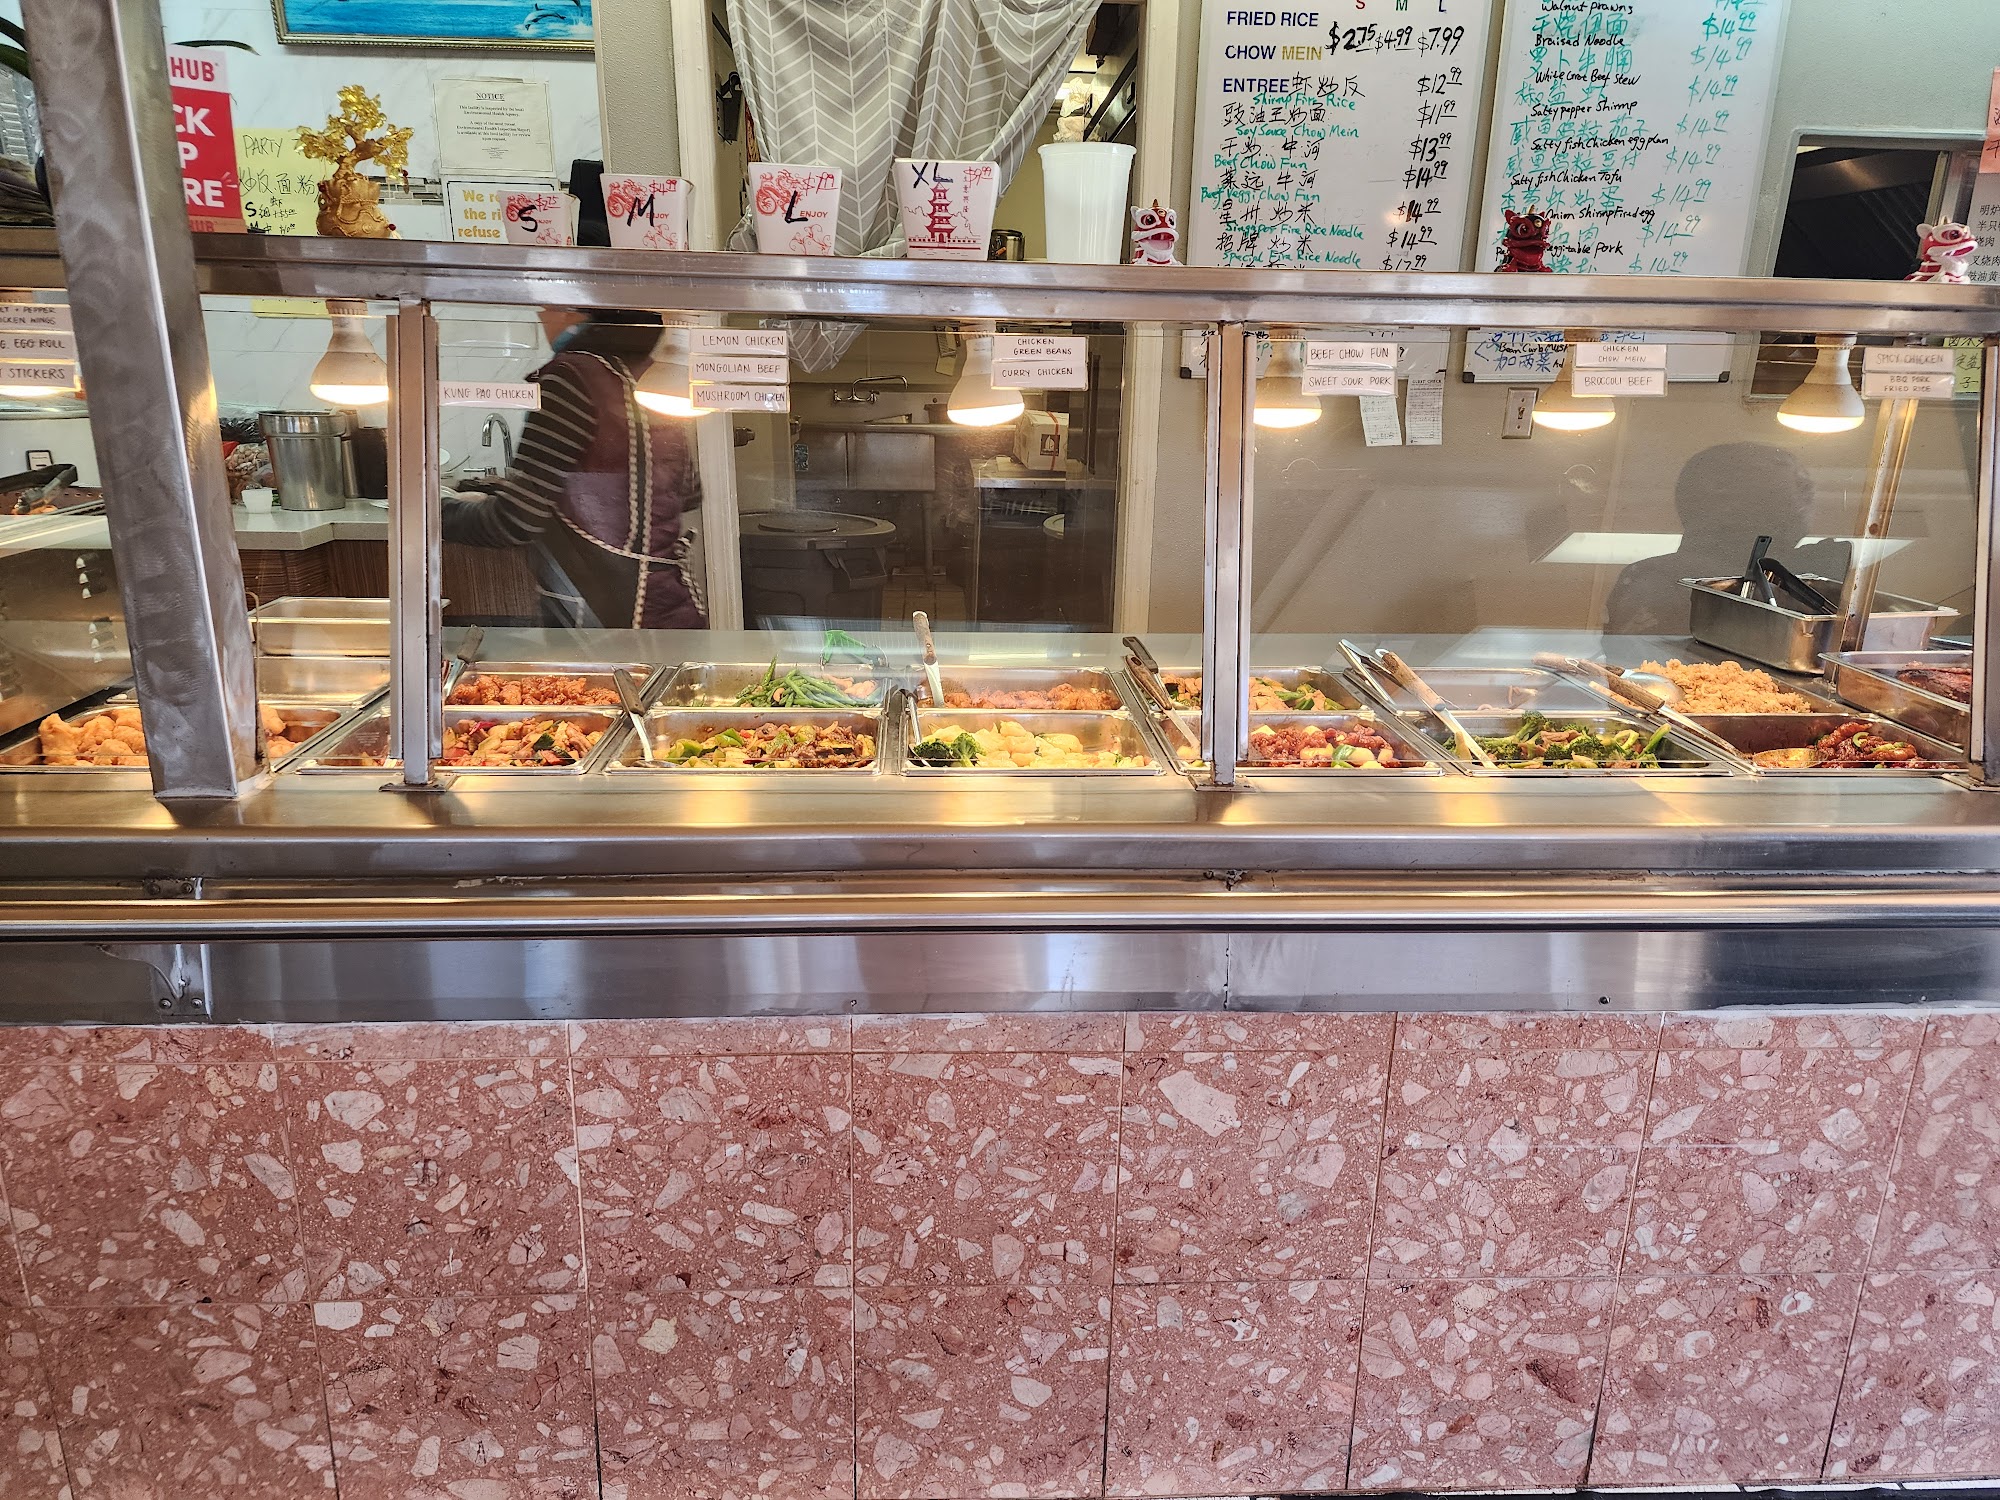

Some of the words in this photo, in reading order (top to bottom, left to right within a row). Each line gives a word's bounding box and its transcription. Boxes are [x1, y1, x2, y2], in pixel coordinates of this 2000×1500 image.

[1355, 0, 1365, 10] S
[1396, 0, 1408, 11] M
[1438, 0, 1447, 13] L
[1542, 0, 1588, 11] Walnut
[1227, 11, 1276, 26] FRIED
[1280, 12, 1319, 27] RICE
[1535, 34, 1580, 47] Braised
[1584, 33, 1624, 47] Noodle
[1225, 45, 1276, 60] CHOW
[1282, 46, 1322, 61] MEIN
[1223, 78, 1290, 93] ENTREE
[1613, 74, 1641, 86] Stew
[476, 93, 504, 101] NOTICE
[1326, 93, 1355, 110] Rice
[1293, 124, 1326, 138] Chow
[1329, 125, 1359, 138] Mein
[243, 134, 283, 158] PARTY
[1586, 135, 1625, 150] Chicken
[1240, 157, 1276, 170] Chow
[1280, 158, 1308, 170] Fun
[1557, 171, 1597, 183] Chicken
[1598, 169, 1622, 185] Tofu
[463, 190, 484, 202] We
[1259, 186, 1290, 202] Chow
[1295, 188, 1321, 202] Fun
[627, 194, 655, 227] M
[785, 190, 808, 223] L
[464, 208, 486, 220] the
[517, 204, 539, 232] S
[1305, 223, 1327, 236] Rice
[1330, 224, 1364, 239] Noodle
[1977, 220, 2000, 231] 半只
[458, 226, 500, 238] refuse
[1297, 250, 1321, 262] Rice
[1325, 251, 1362, 269] Noodle
[39, 339, 65, 349] ROLL
[702, 335, 739, 346] LEMON
[745, 335, 784, 346] CHICKEN
[1311, 348, 1334, 360] BEEF
[1339, 349, 1364, 359] CHOW
[1370, 347, 1389, 359] FUN
[1499, 342, 1521, 353] Bean
[1522, 343, 1543, 353] Curb
[1876, 354, 1900, 364] SPICY
[1904, 354, 1943, 364] CHICKEN
[8, 368, 65, 379] STICKERS
[696, 363, 750, 373] MONGOLIAN
[757, 364, 780, 373] BEEF
[1002, 369, 1030, 377] CURRY
[1037, 368, 1073, 376] CHICKEN
[1308, 376, 1338, 387] SWEET
[1341, 377, 1363, 386] SOUR
[1369, 376, 1392, 386] PORK
[1584, 376, 1621, 386] BROCCOLI
[1628, 376, 1653, 386] BEEF
[444, 387, 471, 399] KUNG
[476, 388, 490, 399] PAO
[496, 388, 533, 399] CHICKEN
[697, 391, 750, 402] MUSHROOM
